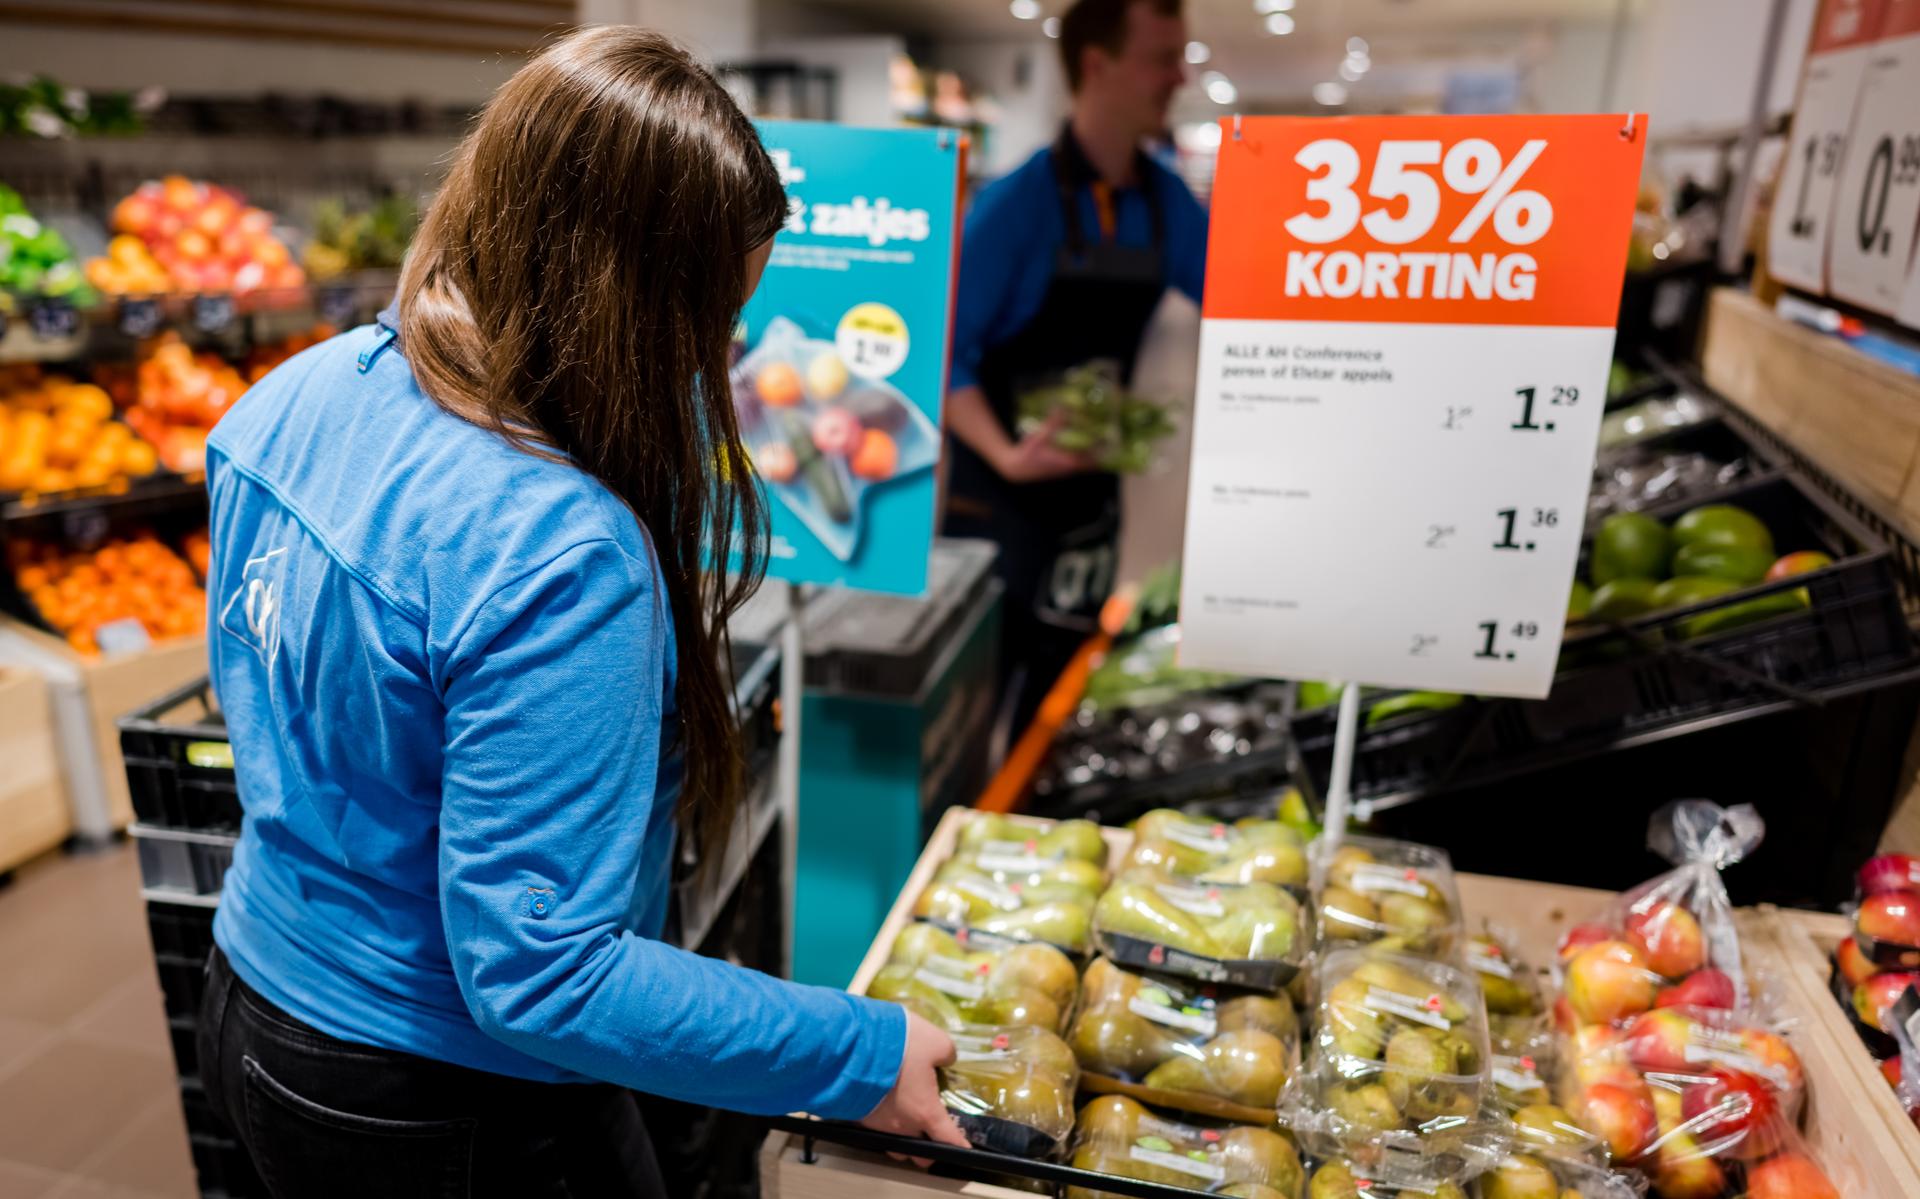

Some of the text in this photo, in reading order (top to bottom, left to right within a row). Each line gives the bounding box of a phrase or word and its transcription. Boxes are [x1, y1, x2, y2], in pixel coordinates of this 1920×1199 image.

[1284, 137, 1554, 245] 35%
[810, 195, 930, 247] zakjes
[1285, 250, 1538, 301] KORTING
[1221, 366, 1393, 383] peren of Elstar appels
[1223, 344, 1384, 362] ALLE AH Conference
